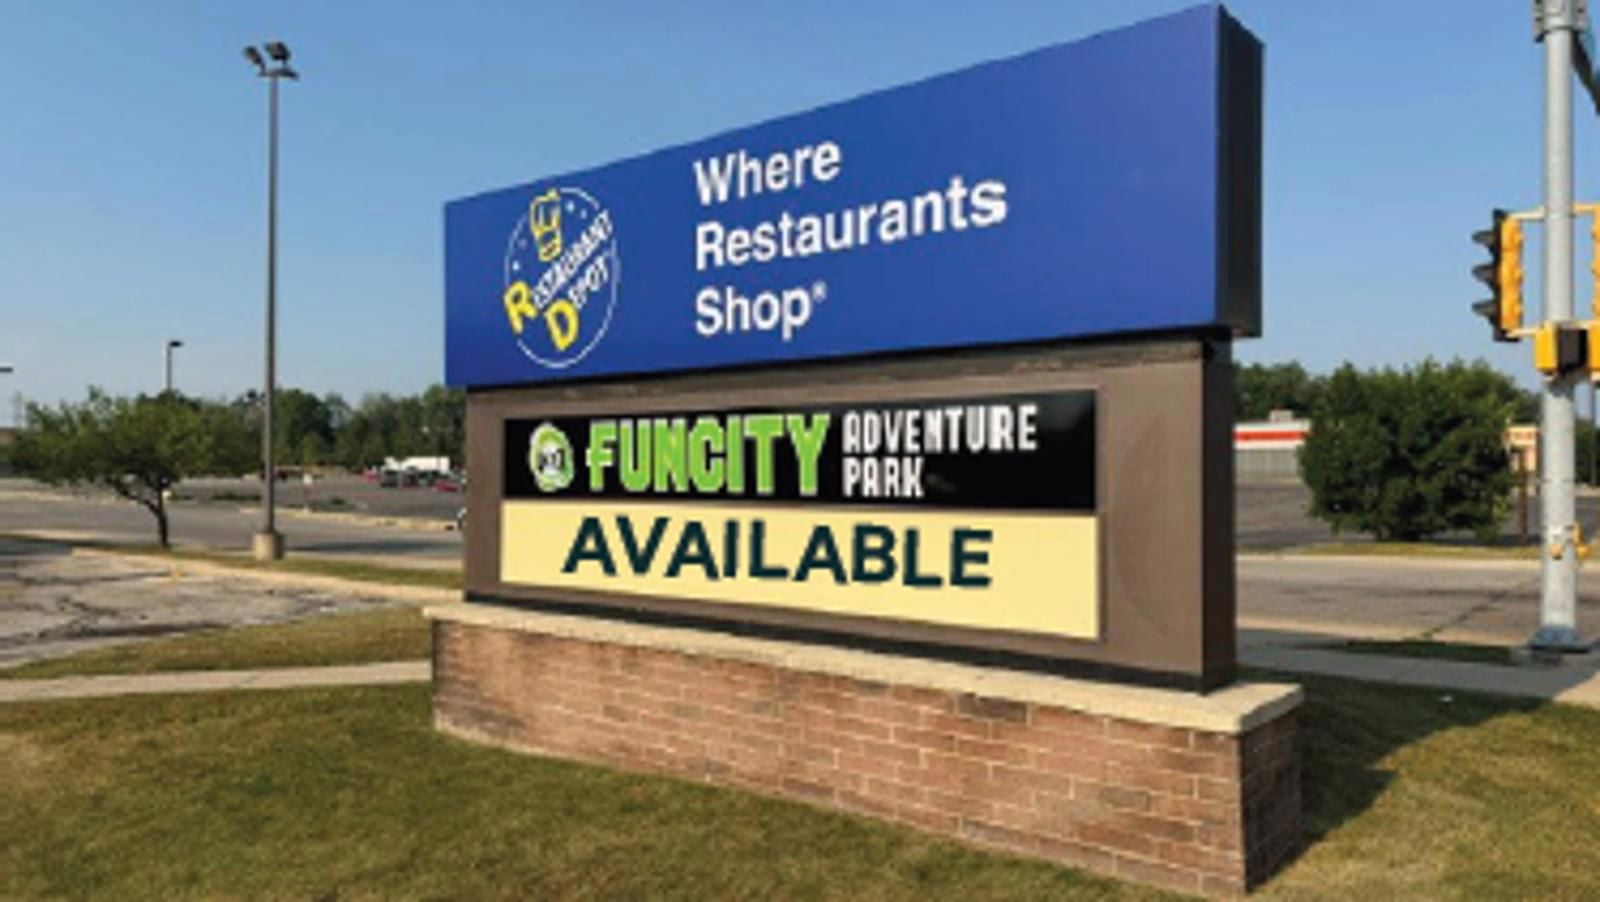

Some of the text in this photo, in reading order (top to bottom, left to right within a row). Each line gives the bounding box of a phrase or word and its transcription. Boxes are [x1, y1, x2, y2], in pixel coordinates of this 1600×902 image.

[693, 141, 841, 206] Where
[695, 176, 1008, 271] Restaurants
[503, 209, 613, 334] RESTAURANT
[544, 254, 609, 351] DEPOT
[585, 413, 831, 496] FUNCITY
[842, 404, 1038, 454] ADVENTURE
[842, 456, 925, 498] PARK
[561, 516, 994, 588] AVAILABLE
